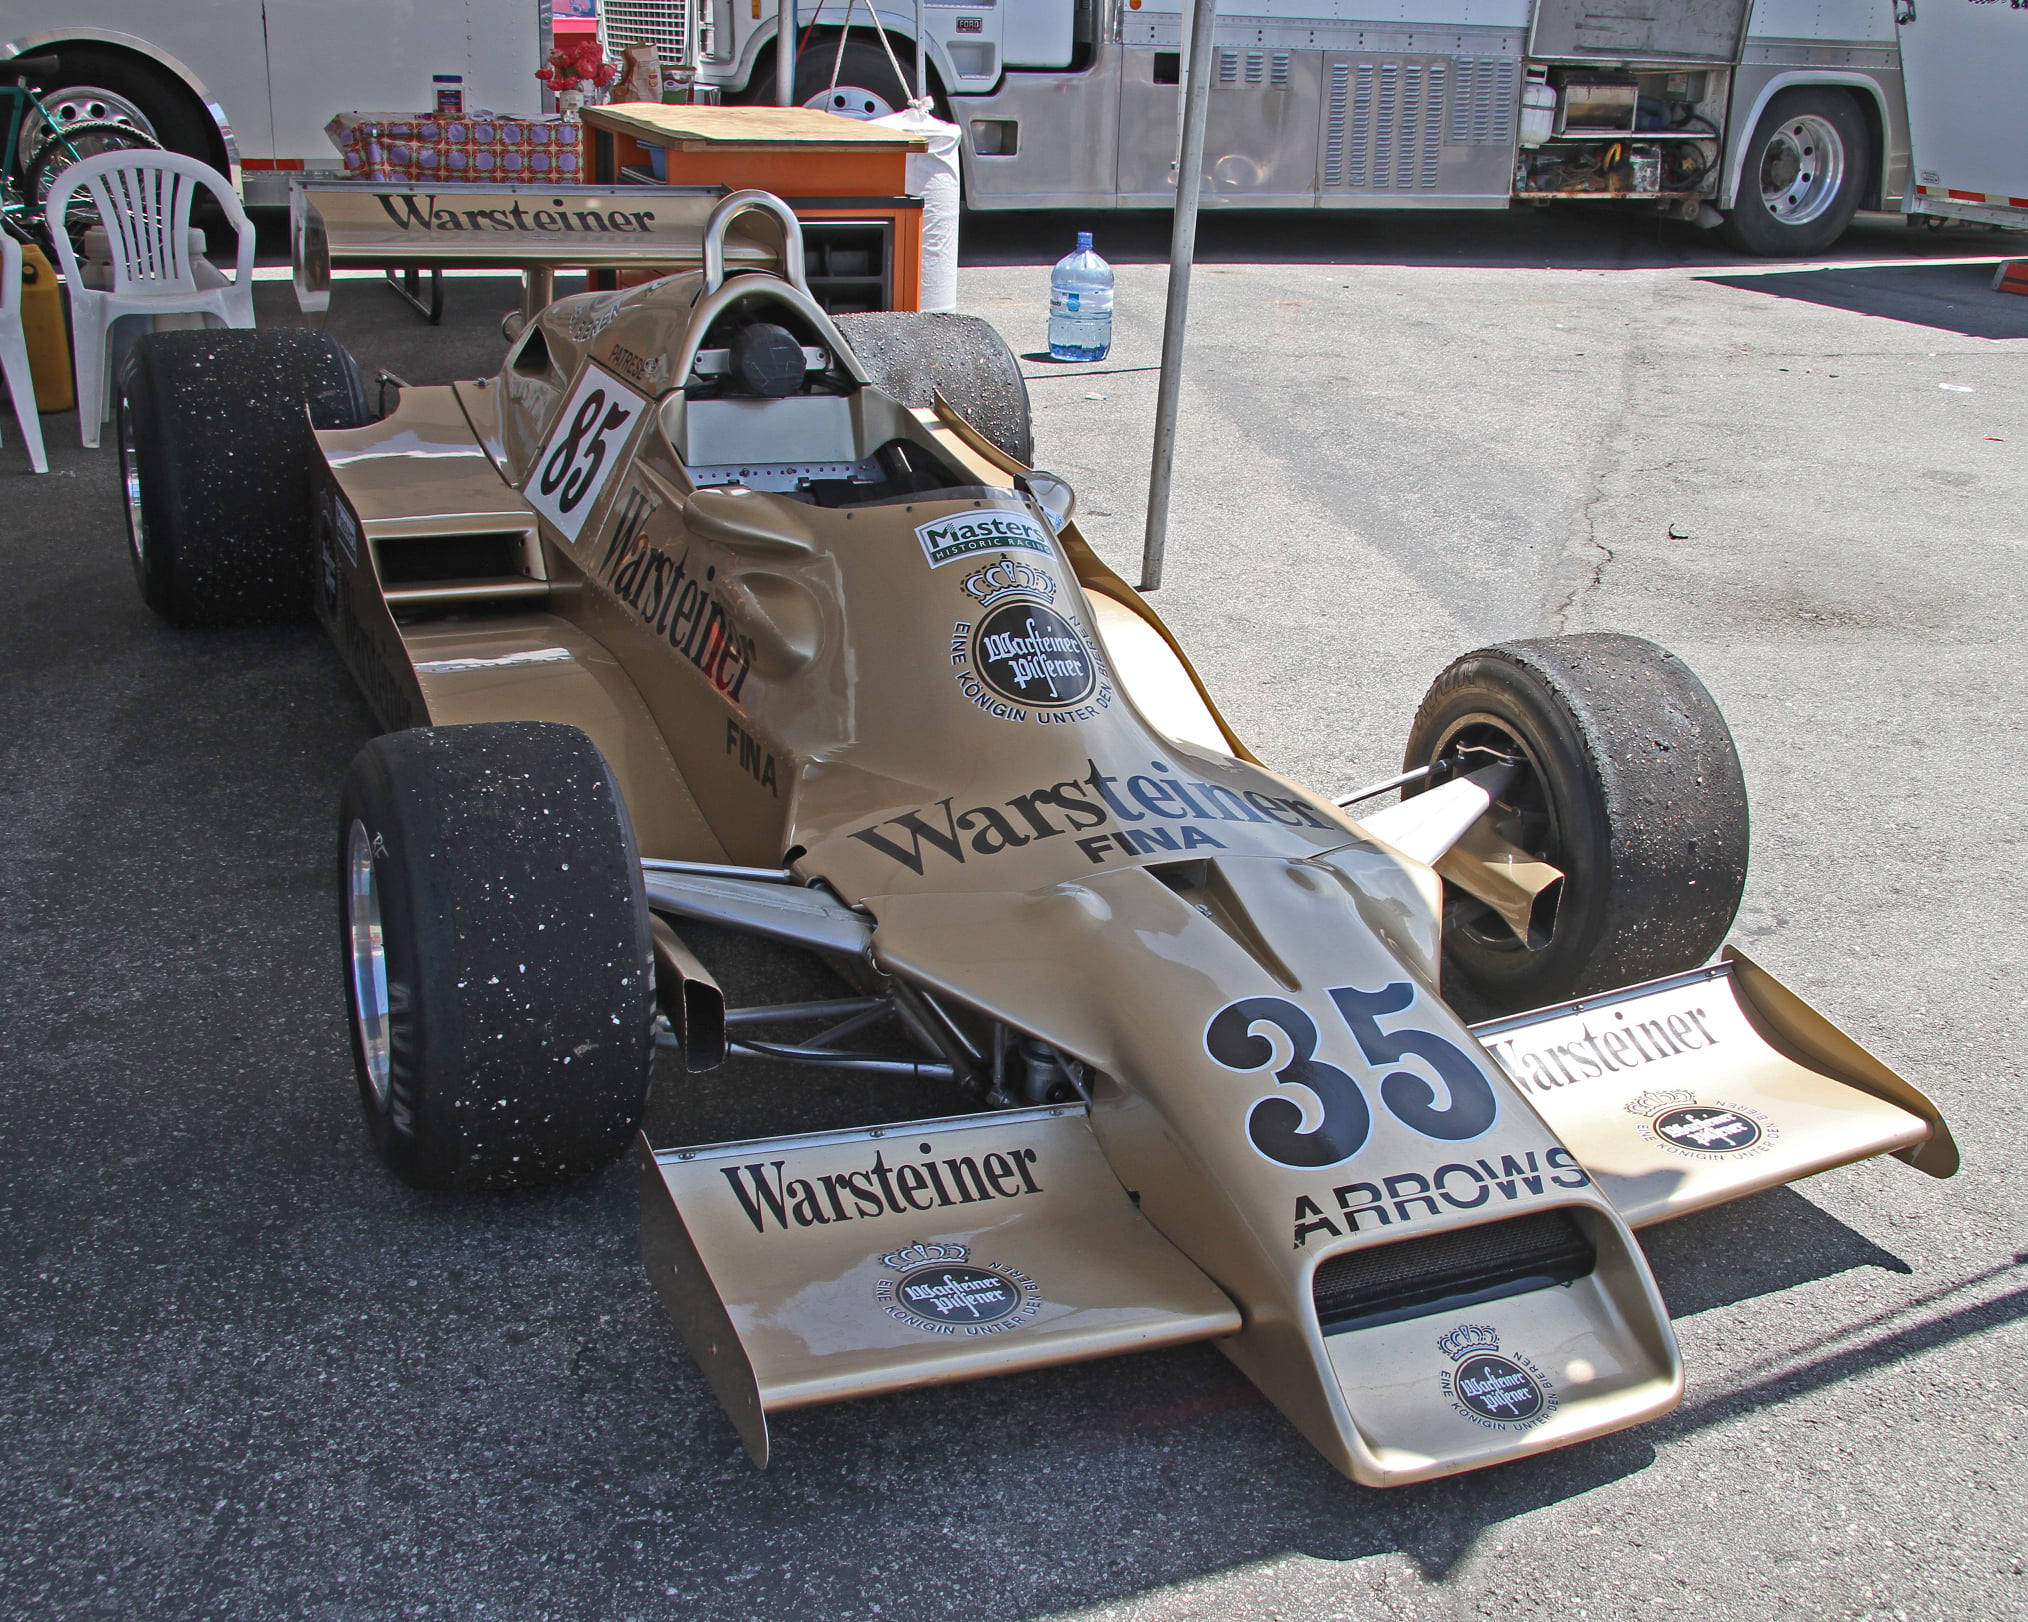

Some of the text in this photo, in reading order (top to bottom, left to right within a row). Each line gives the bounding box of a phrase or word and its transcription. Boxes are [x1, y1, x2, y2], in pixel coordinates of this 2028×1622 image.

[959, 20, 979, 29] FORD
[372, 193, 656, 232] Warsteiner
[540, 388, 631, 514] 85
[926, 518, 1046, 550] Masters
[935, 537, 1051, 560] HISTORIC RACING
[598, 486, 759, 704] Warsteiner
[950, 621, 972, 666] EINE
[955, 670, 1027, 723] KÖNIGIN
[1096, 682, 1113, 709] DEN
[1036, 705, 1101, 726] UNTER
[725, 716, 779, 798] FINA
[847, 758, 1337, 877] Warsteiner
[1074, 824, 1228, 864] FINA
[1202, 982, 1499, 1170] 35
[1636, 1123, 1657, 1142] EINE
[720, 1142, 1044, 1233] Warsteiner
[1292, 1147, 1592, 1250] ARROWS
[876, 1278, 894, 1302] EINE
[988, 1261, 1041, 1293] BIEREN
[1021, 1295, 1042, 1316] DEN
[964, 1316, 1026, 1337] UNTER
[1440, 1370, 1454, 1398] EINE
[1513, 1352, 1553, 1389] BIEREN
[1547, 1393, 1560, 1413] DEN
[1513, 1413, 1553, 1432] UNTER
